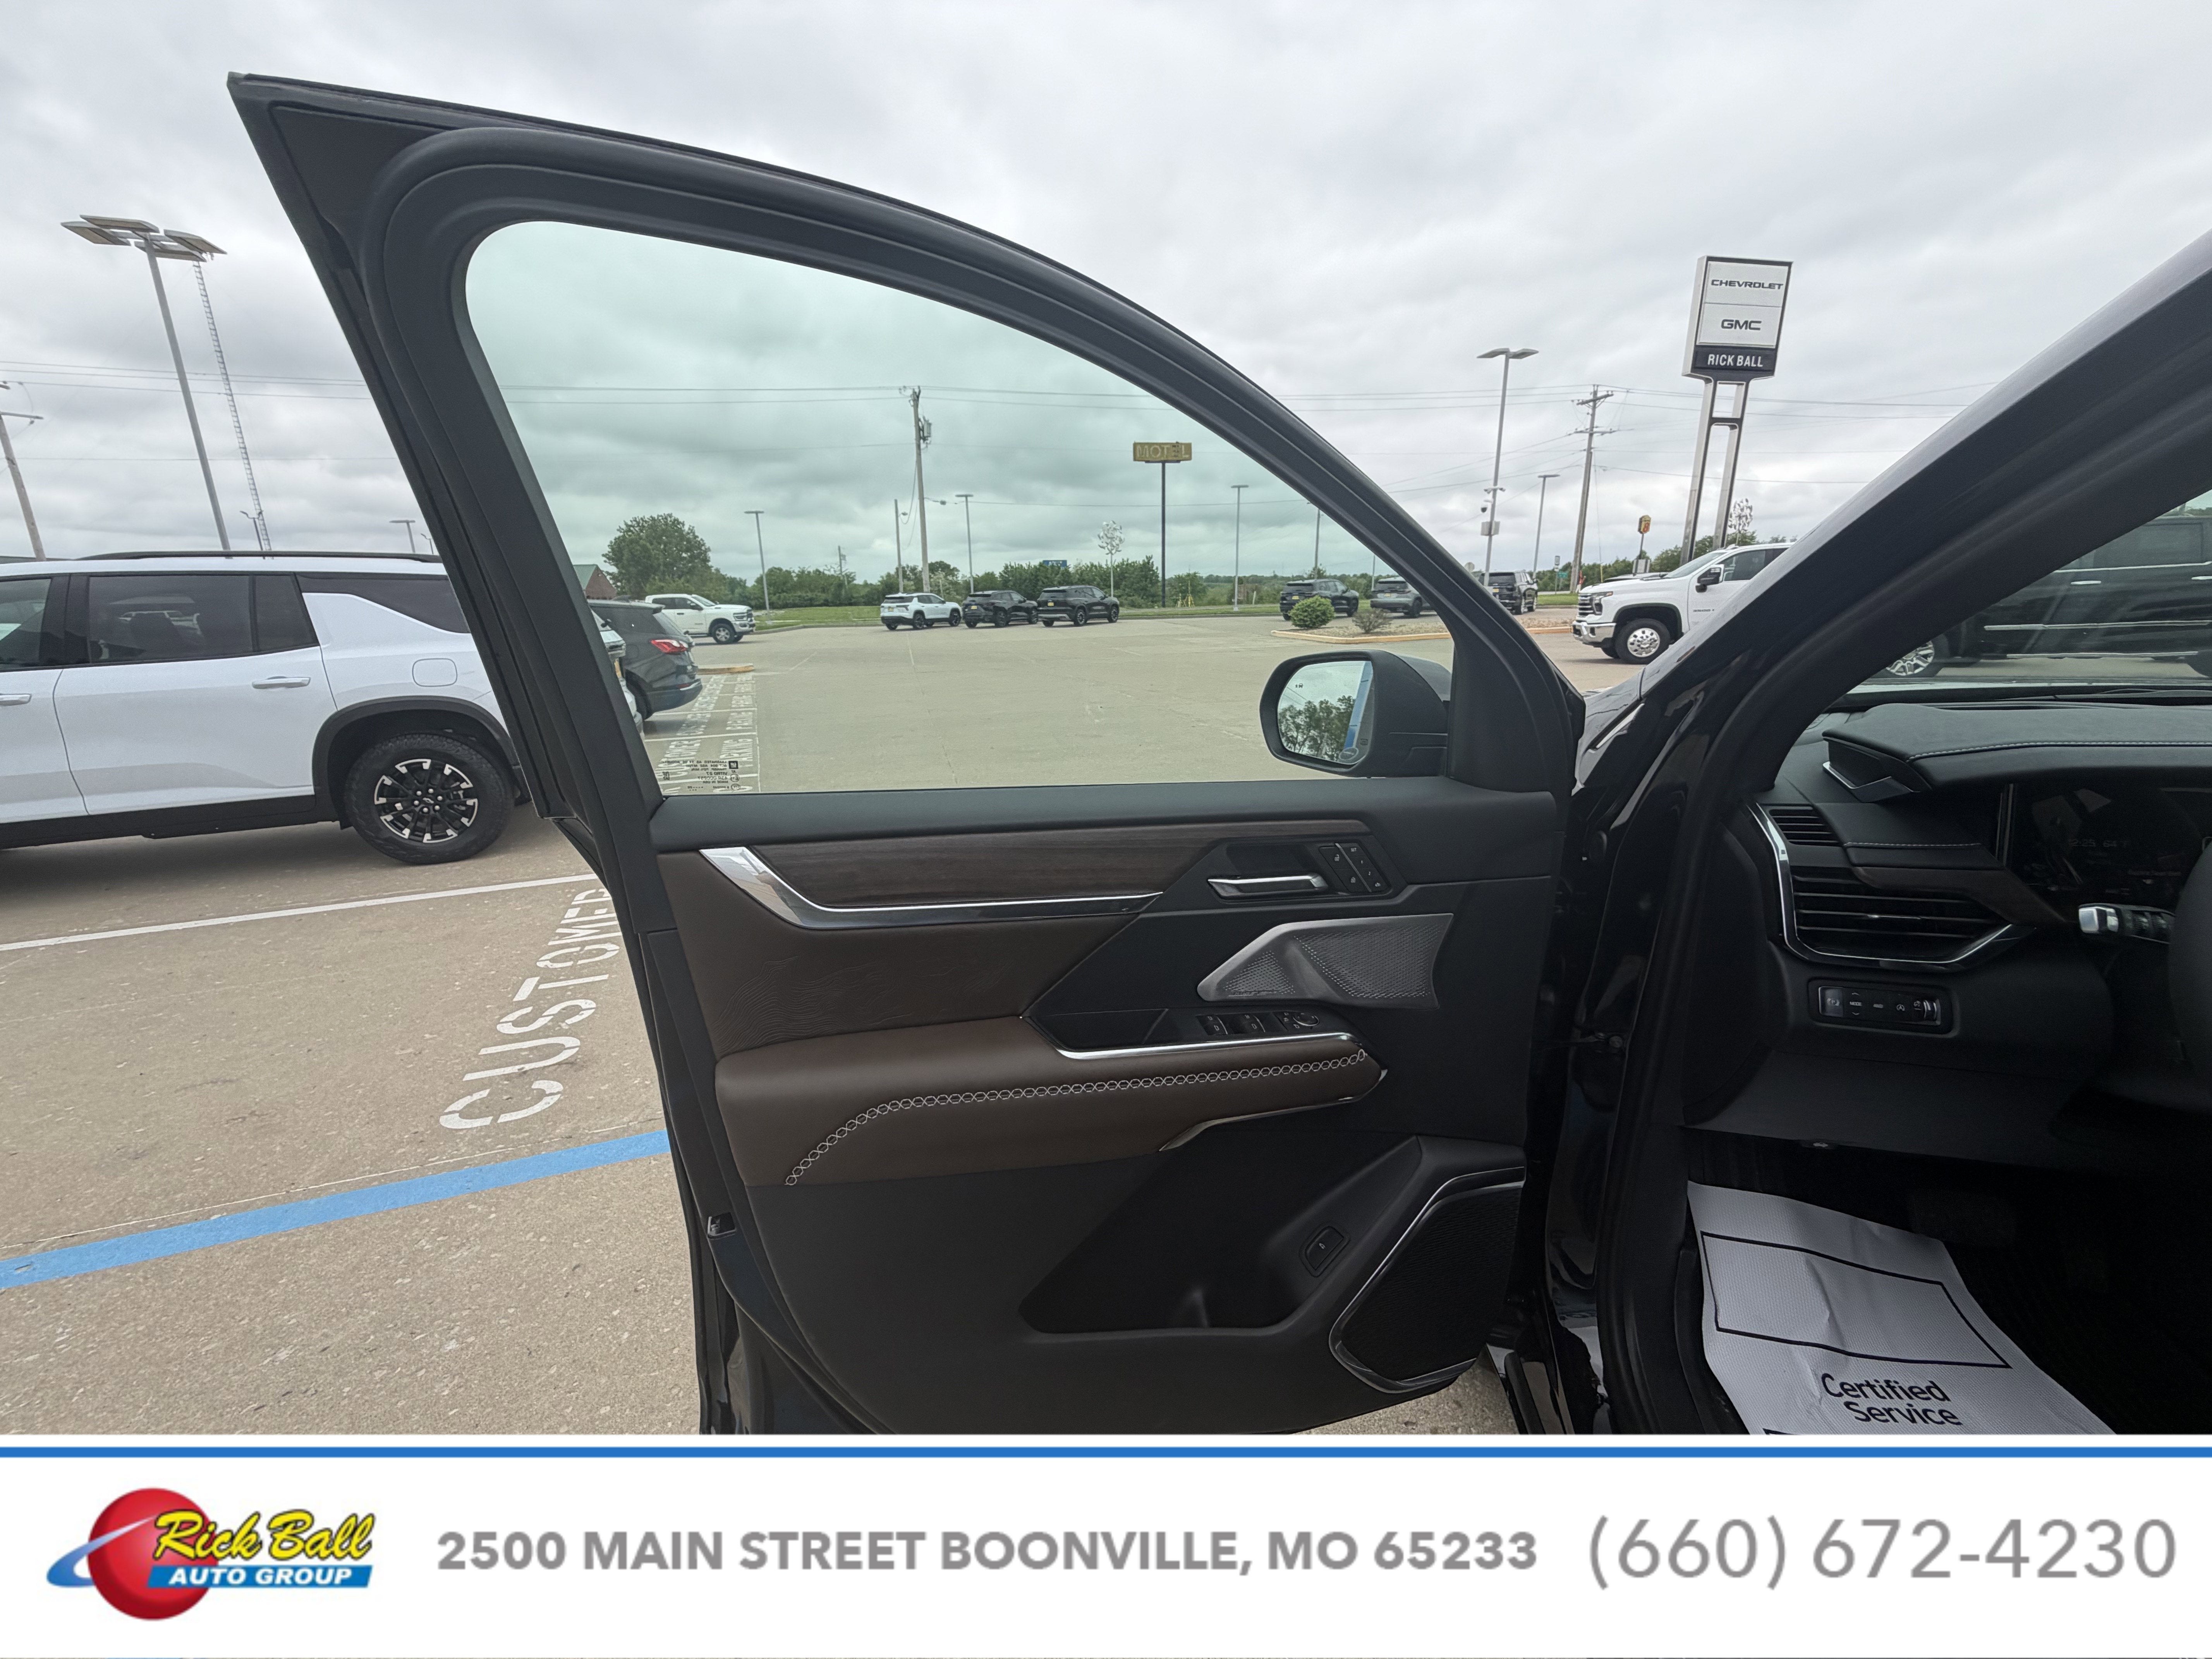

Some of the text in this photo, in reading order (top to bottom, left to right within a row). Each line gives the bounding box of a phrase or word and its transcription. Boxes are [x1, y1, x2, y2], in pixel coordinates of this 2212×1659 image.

[1711, 279, 1783, 290] CHEVROLET
[1721, 319, 1762, 330] GMC
[1707, 354, 1763, 367] RICK BALL
[1137, 445, 1189, 458] MOTL
[1821, 1373, 1952, 1402] Certified
[1843, 1401, 1963, 1426] Service
